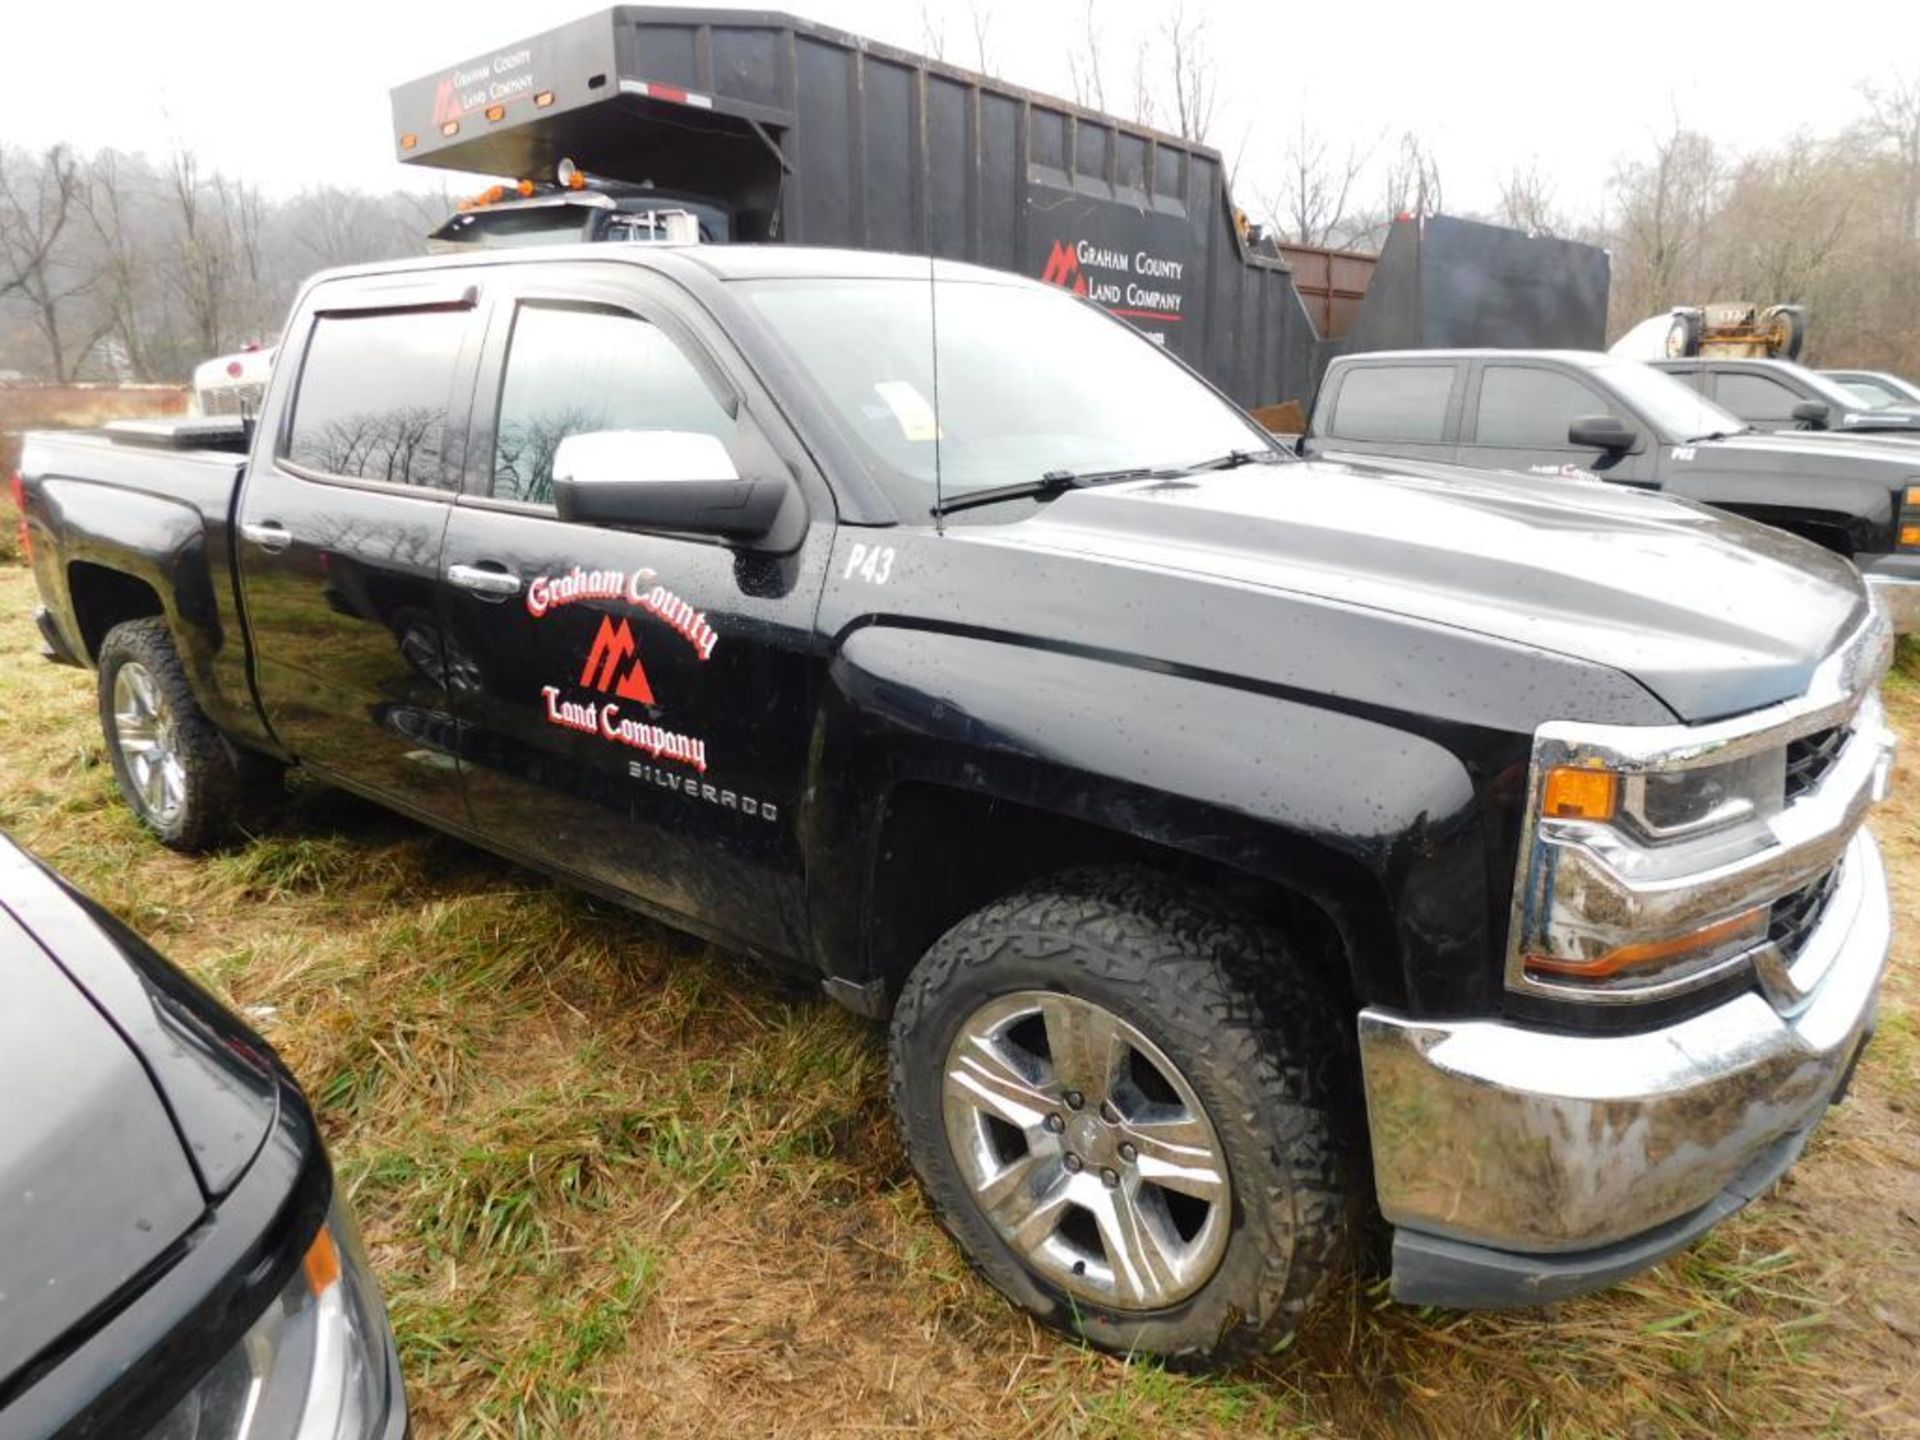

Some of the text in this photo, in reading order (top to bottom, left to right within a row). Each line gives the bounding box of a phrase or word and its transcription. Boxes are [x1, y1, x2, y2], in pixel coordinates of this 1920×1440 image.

[1088, 276, 1182, 311] LAND COMPANY
[843, 543, 896, 585] P43
[527, 565, 719, 661] Graham County
[541, 685, 708, 774] Land Company
[628, 760, 779, 822] SILVERADO
